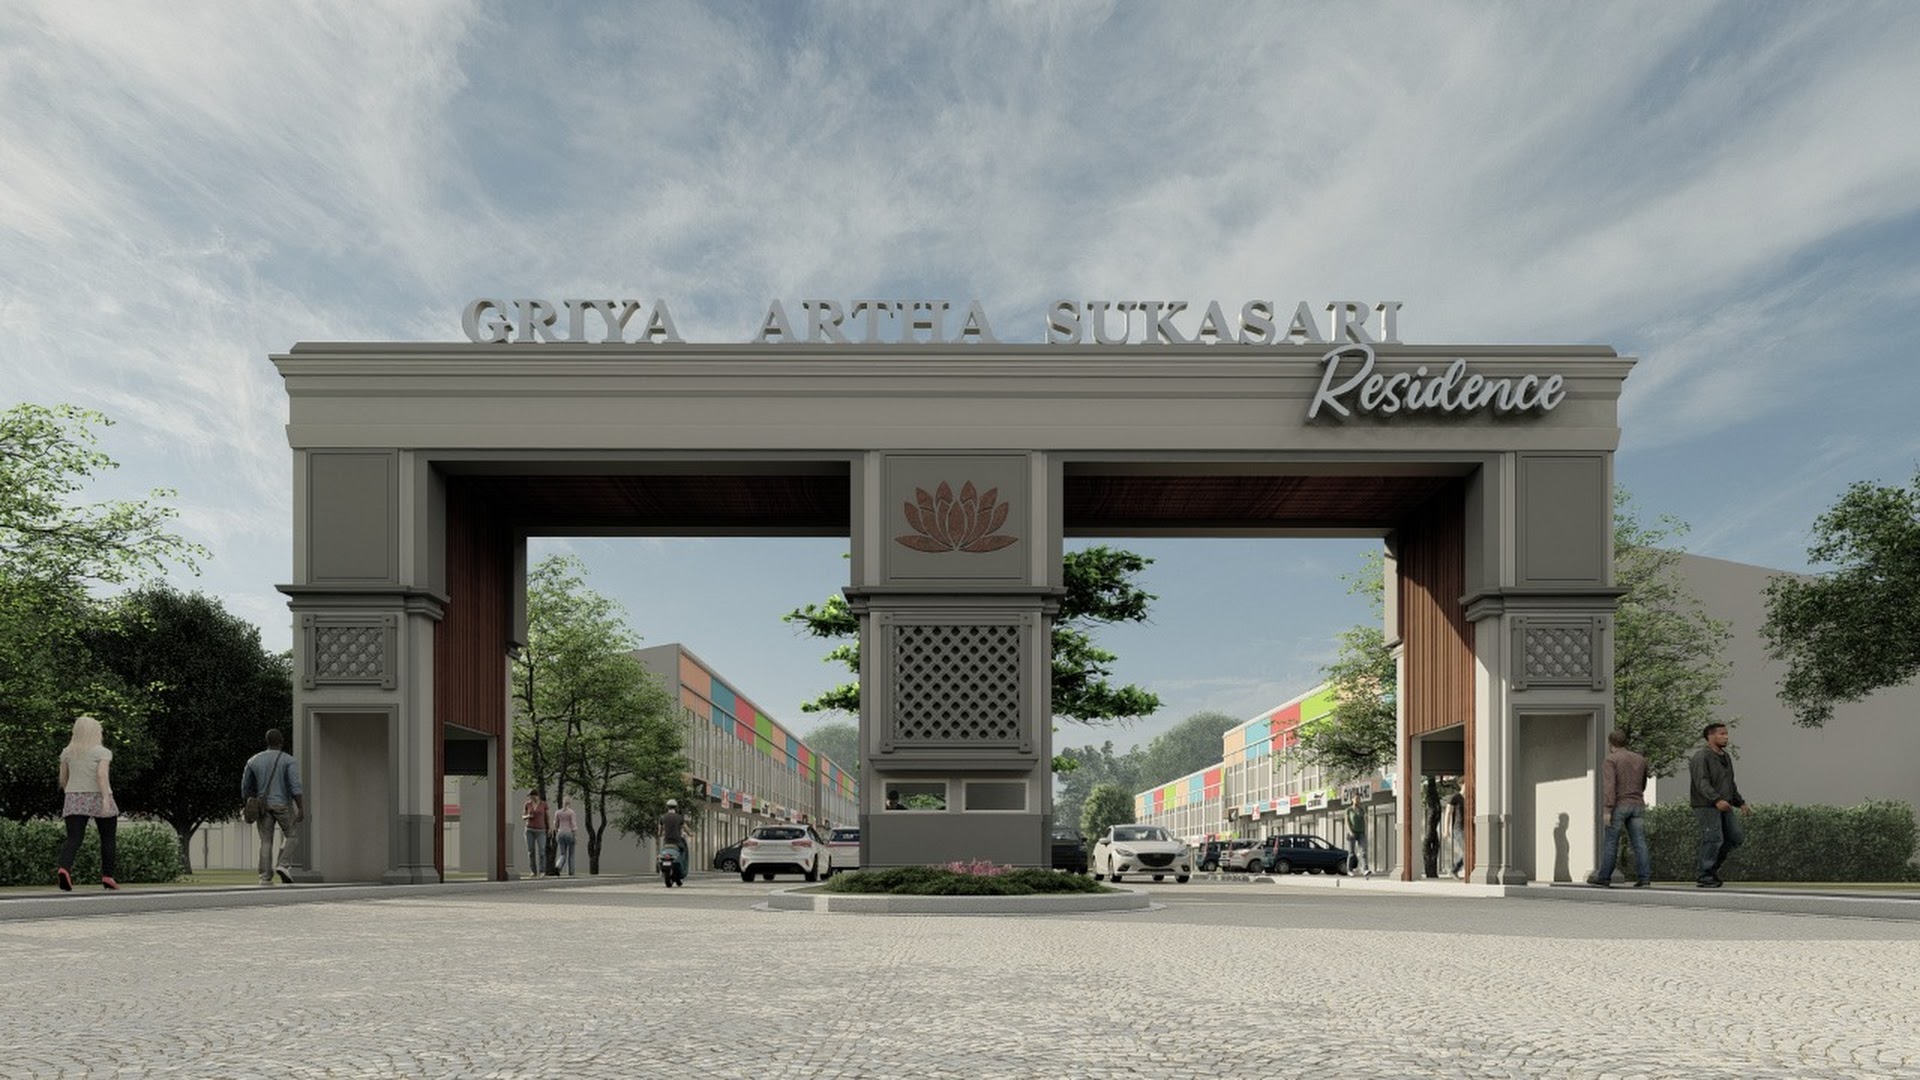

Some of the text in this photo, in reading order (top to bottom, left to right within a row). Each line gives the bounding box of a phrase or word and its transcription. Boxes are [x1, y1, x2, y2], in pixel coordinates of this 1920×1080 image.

[461, 299, 1403, 345] GRIYA ARTHA SUKASARI
[1306, 343, 1566, 423] Residence
